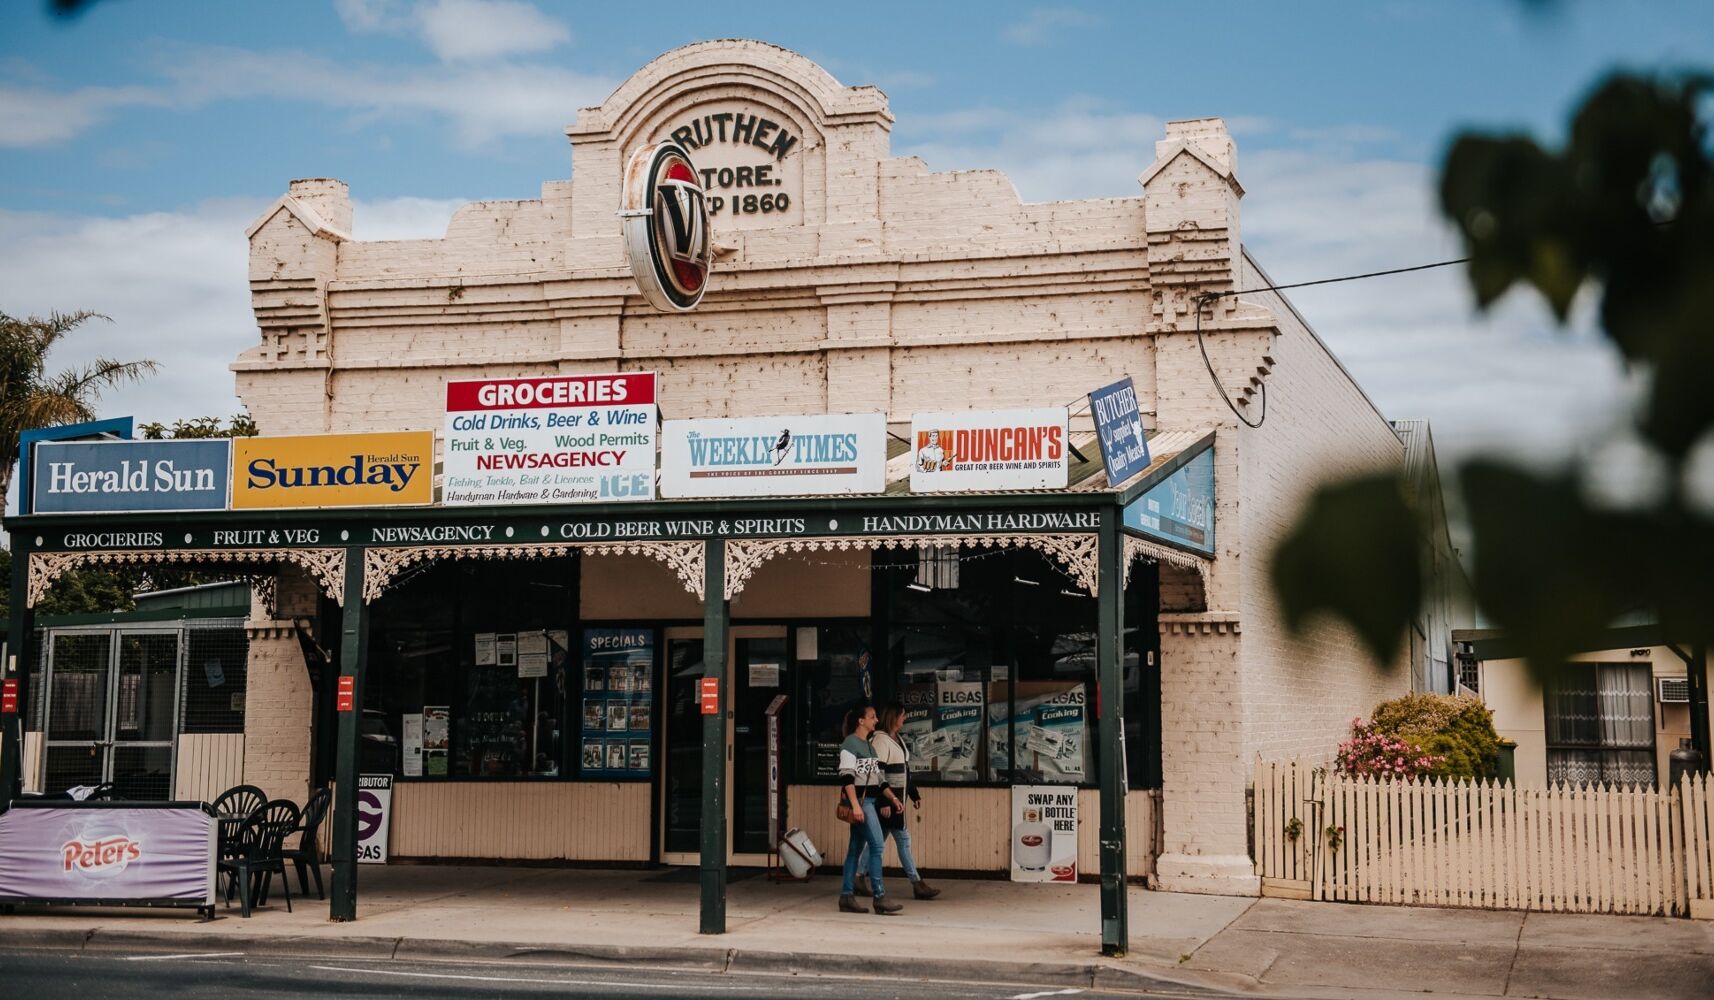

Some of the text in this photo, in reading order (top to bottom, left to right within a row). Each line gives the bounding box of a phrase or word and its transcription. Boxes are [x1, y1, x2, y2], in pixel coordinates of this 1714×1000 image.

[669, 112, 799, 162] RUTHEN
[699, 165, 782, 190] TORE.
[732, 193, 789, 216] 1860
[478, 378, 628, 407] GROCERIES
[1095, 386, 1138, 426] BUTCHER
[452, 408, 648, 431] Cold Drinks, Beer & Wine
[451, 431, 649, 453] Fruit & Veg. Wood Permits
[686, 429, 701, 440] The
[955, 426, 1062, 463] DUNCAN'S
[367, 453, 420, 463] Herald Sun
[477, 450, 627, 470] NEWSAGENCY
[688, 433, 858, 467] WEEKLY TIMES
[48, 459, 216, 494] Herald Sun
[248, 455, 420, 492] Sunday
[955, 461, 1061, 471] GREAT FOR BEER WINE AND SPIRITS
[448, 475, 482, 489] Fishing
[519, 473, 541, 485] Bait
[542, 473, 552, 485] &
[554, 472, 594, 485] Licences
[600, 472, 650, 498] ICE
[447, 487, 598, 503] Handyman Hardware & Gardening
[64, 511, 1100, 547] GROCIERIES FRUIT & VEG NEWSAGENCY COLD BEER WINE & SPIRITS HANDYMAN HARDWARE
[590, 634, 646, 650] SPECIALS
[943, 691, 982, 704] ELGAS
[941, 708, 978, 721] Cooking
[1042, 708, 1079, 721] Cooking
[1028, 793, 1075, 806] SWAP ANY
[1045, 807, 1075, 819] BOTTLE
[1053, 820, 1075, 832] HERE
[62, 836, 141, 872] Peters
